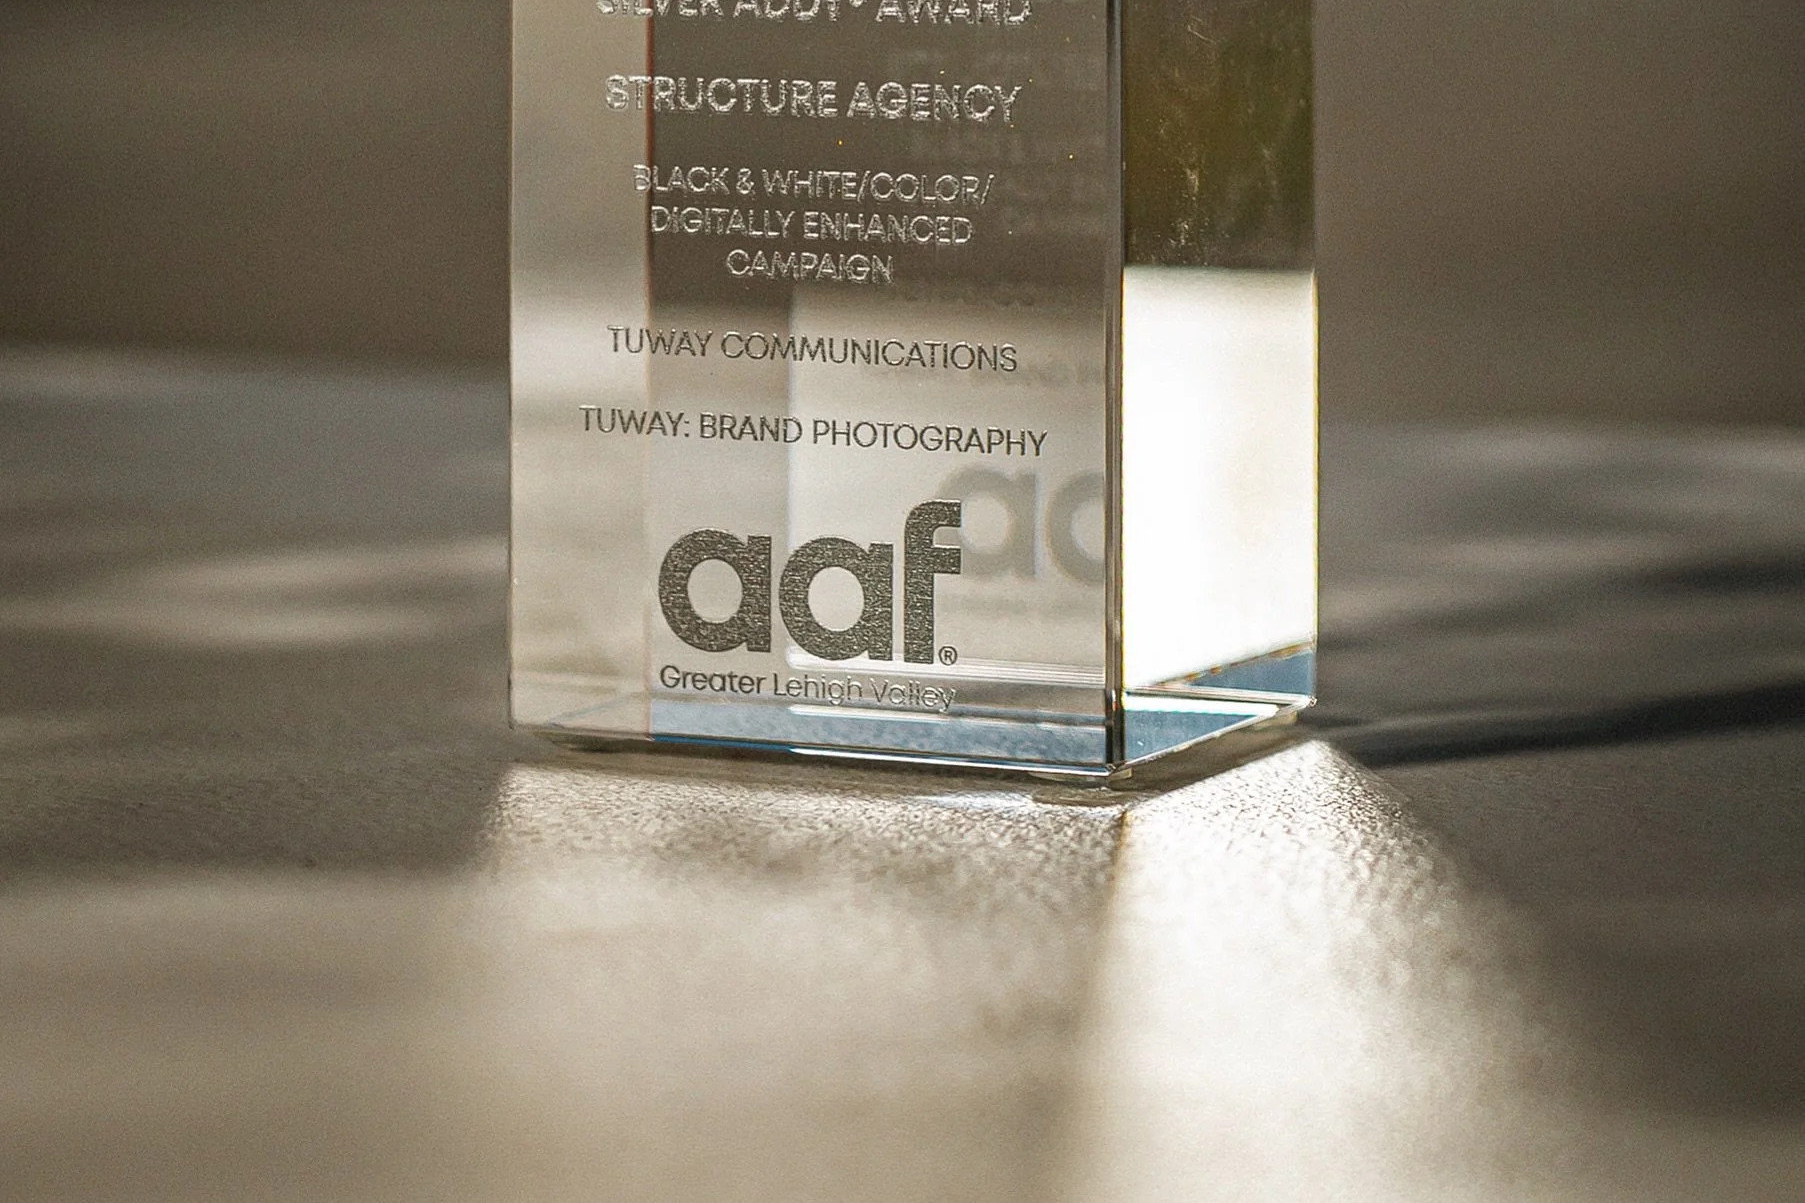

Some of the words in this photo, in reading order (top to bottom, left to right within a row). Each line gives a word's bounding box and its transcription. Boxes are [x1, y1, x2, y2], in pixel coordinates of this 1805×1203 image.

[605, 75, 837, 118] STRUCTURE
[846, 82, 1022, 122] AGENCY
[632, 164, 729, 194] BLACK
[736, 168, 755, 195] &
[651, 206, 794, 238] DIGITALLY
[803, 211, 974, 245] ENHANCED
[726, 250, 894, 284] CAMPAIGN
[607, 325, 712, 358] TUWAY
[721, 331, 1018, 372] COMMUNICATIONS
[579, 405, 690, 439] TUWAY:
[700, 413, 802, 445] BRAND
[813, 419, 1048, 457] PHOTOGRAPHY
[660, 665, 767, 699] Greater
[773, 673, 862, 709] Lehigh
[870, 678, 956, 713] Valley
